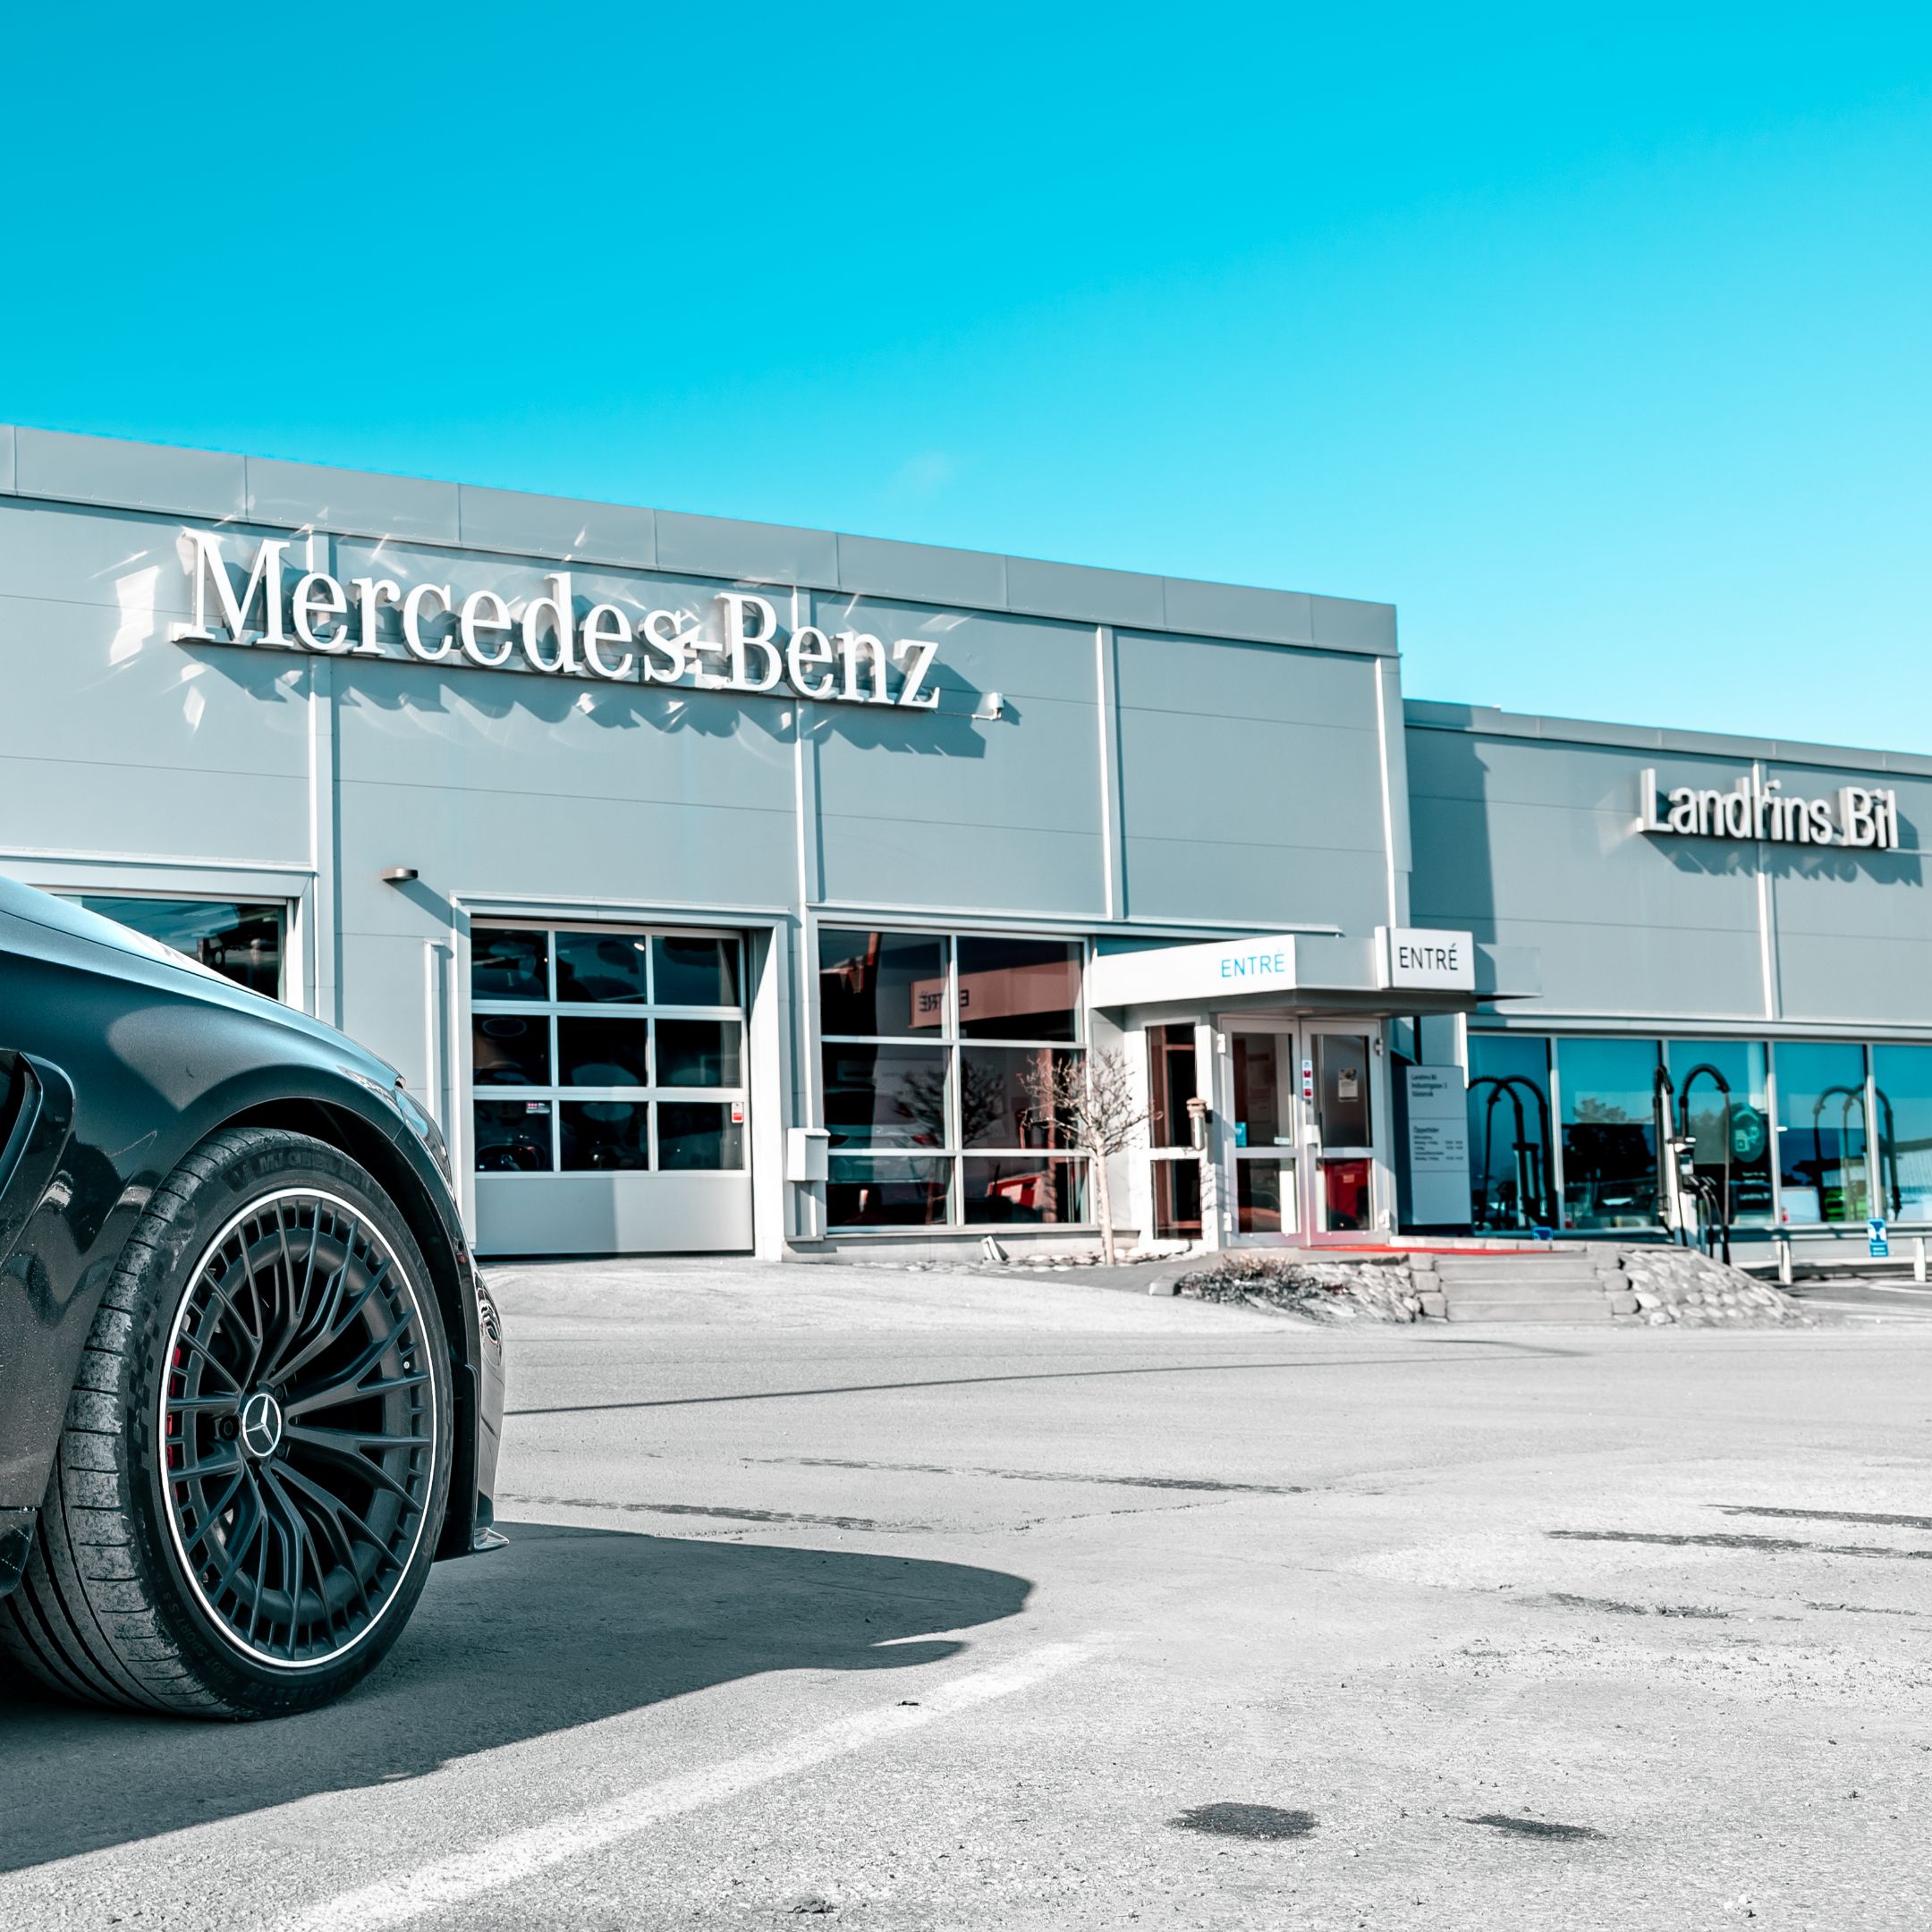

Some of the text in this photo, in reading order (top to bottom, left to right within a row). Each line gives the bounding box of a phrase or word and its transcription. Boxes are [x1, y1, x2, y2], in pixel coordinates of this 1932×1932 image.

[182, 528, 941, 709] Mercedes-Benz
[1640, 767, 1899, 849] Landrins Bil
[1221, 948, 1285, 978] ENTRÉ
[1400, 943, 1459, 971] ENTRÉ
[175, 1618, 208, 1657] SPORT
